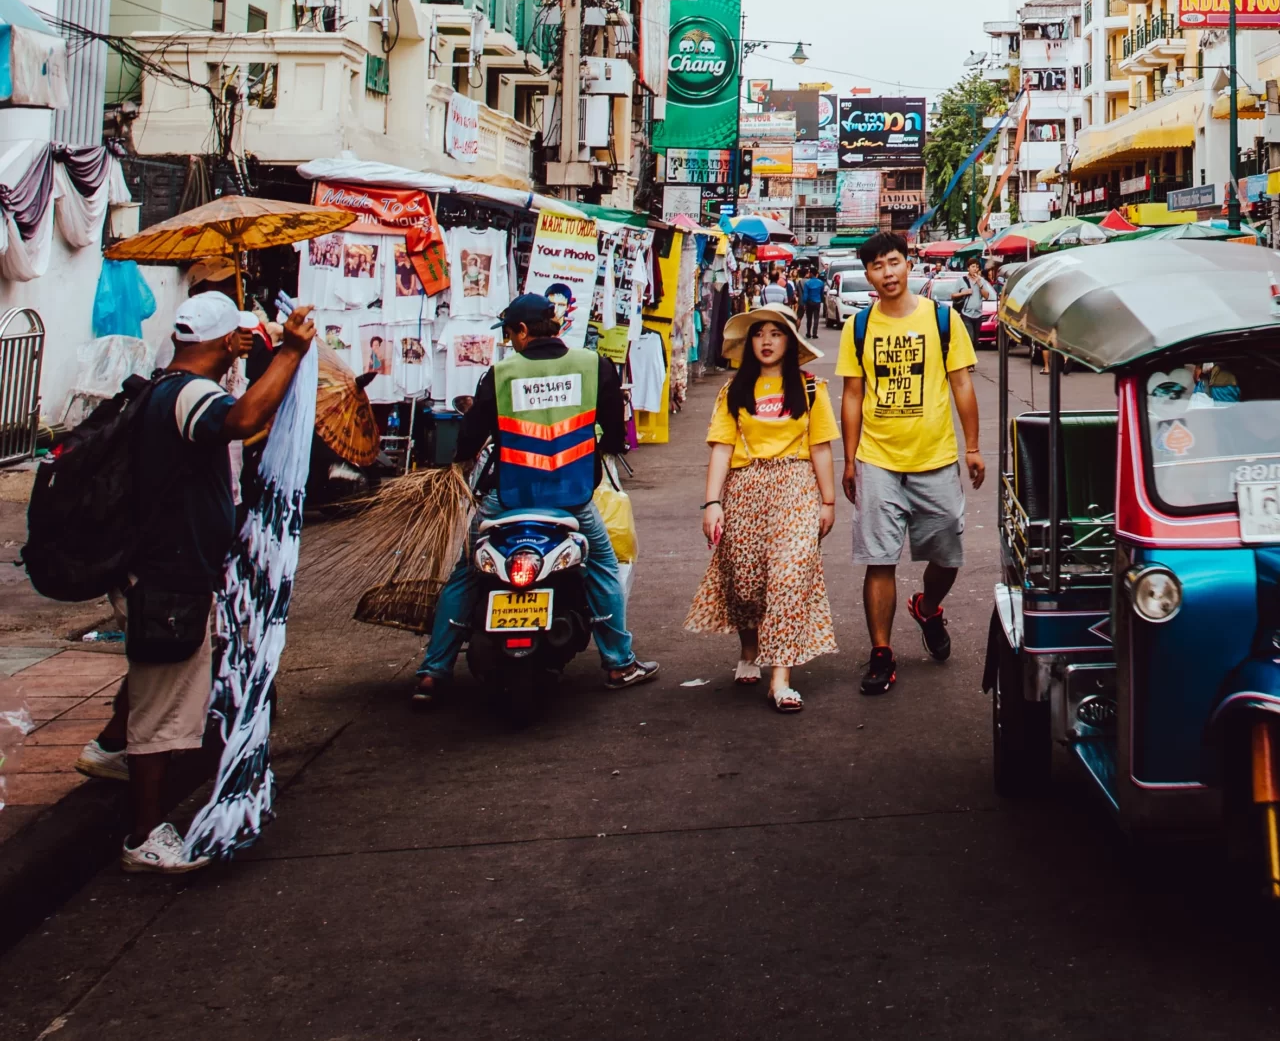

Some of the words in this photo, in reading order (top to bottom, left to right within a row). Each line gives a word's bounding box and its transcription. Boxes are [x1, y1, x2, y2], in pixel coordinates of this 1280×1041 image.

[668, 53, 727, 77] Chang
[882, 194, 919, 203] INDIAN
[887, 203, 914, 211] FOOD
[540, 214, 563, 234] MADE
[565, 217, 576, 235] TO
[537, 243, 563, 257] Your
[563, 247, 596, 262] Photo
[552, 273, 584, 284] Design
[893, 335, 912, 349] AM
[878, 349, 903, 363] ONE
[904, 348, 920, 362] OF
[522, 380, 572, 394] พระนคร
[529, 394, 567, 405] 01-419
